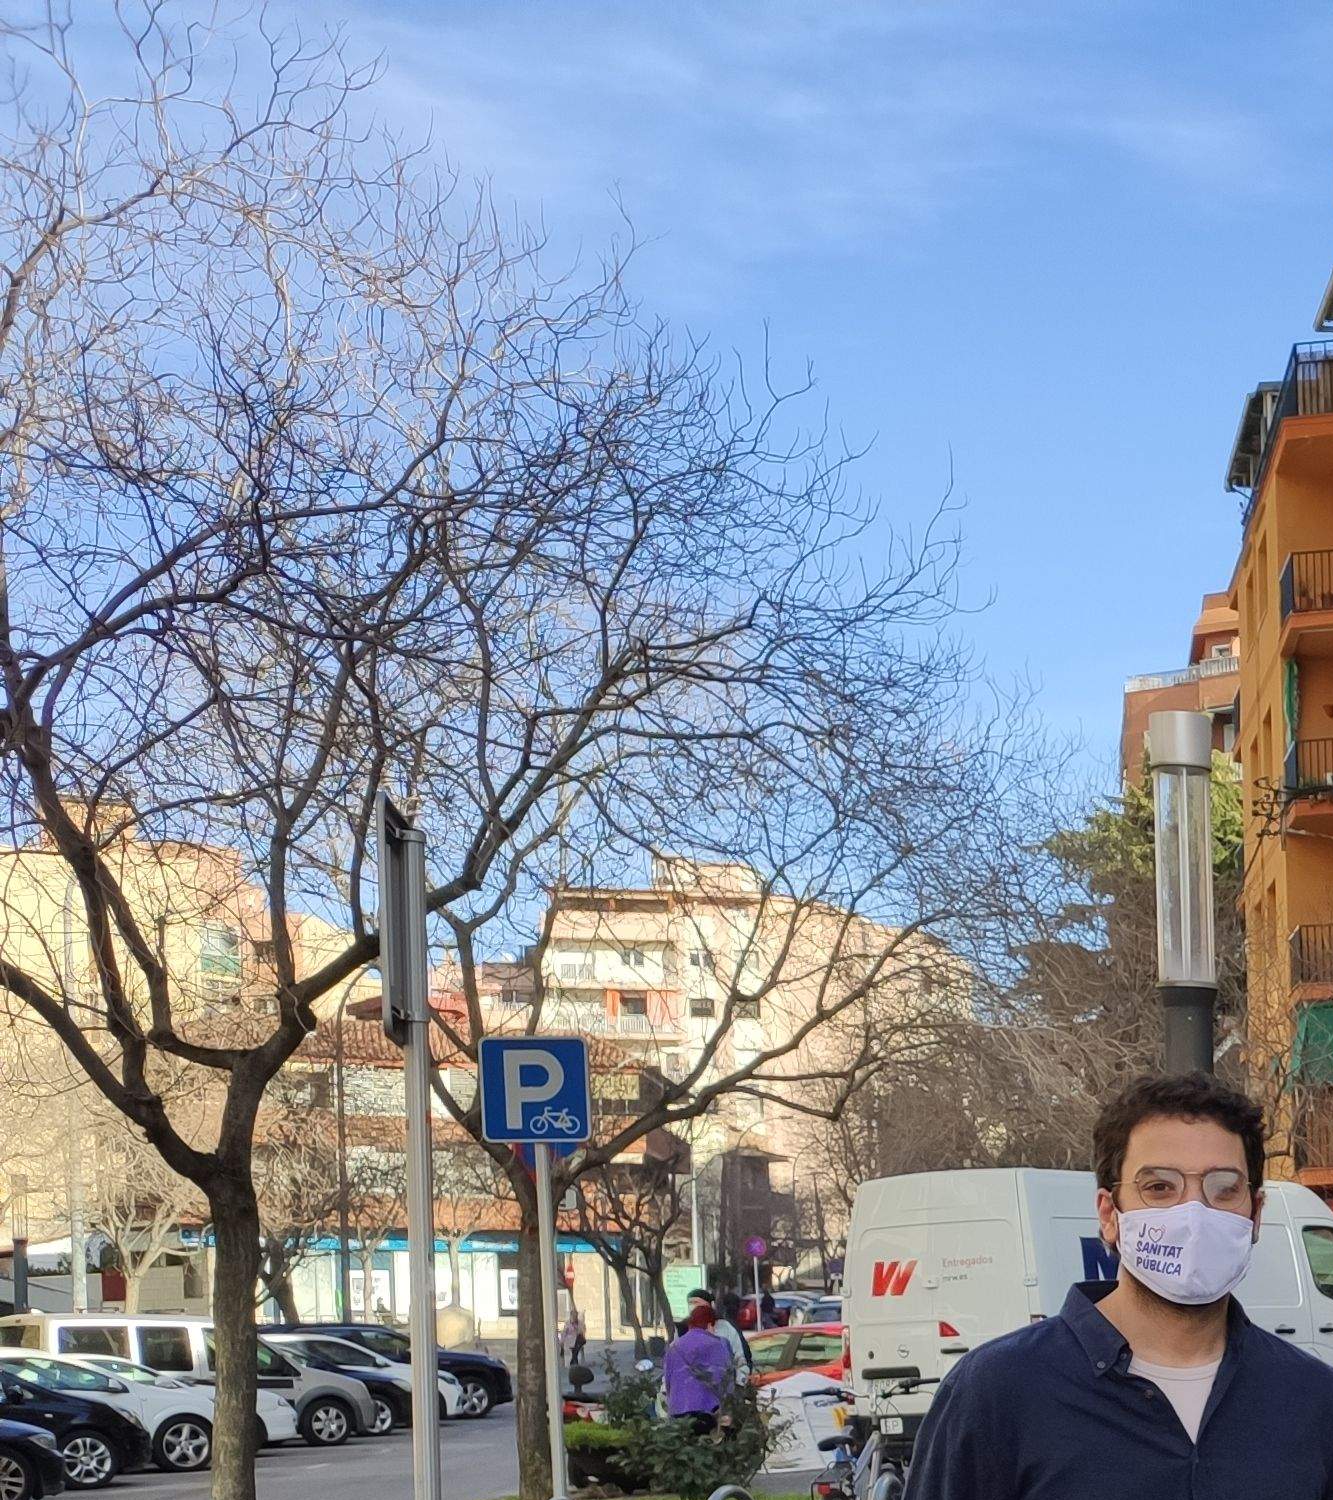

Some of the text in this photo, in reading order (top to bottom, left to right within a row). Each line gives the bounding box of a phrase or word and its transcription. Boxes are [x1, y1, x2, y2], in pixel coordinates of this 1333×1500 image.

[503, 1049, 564, 1129] P
[1138, 1223, 1147, 1238] J
[1136, 1241, 1183, 1258] SANITAT
[1136, 1255, 1182, 1276] PÚBLICA
